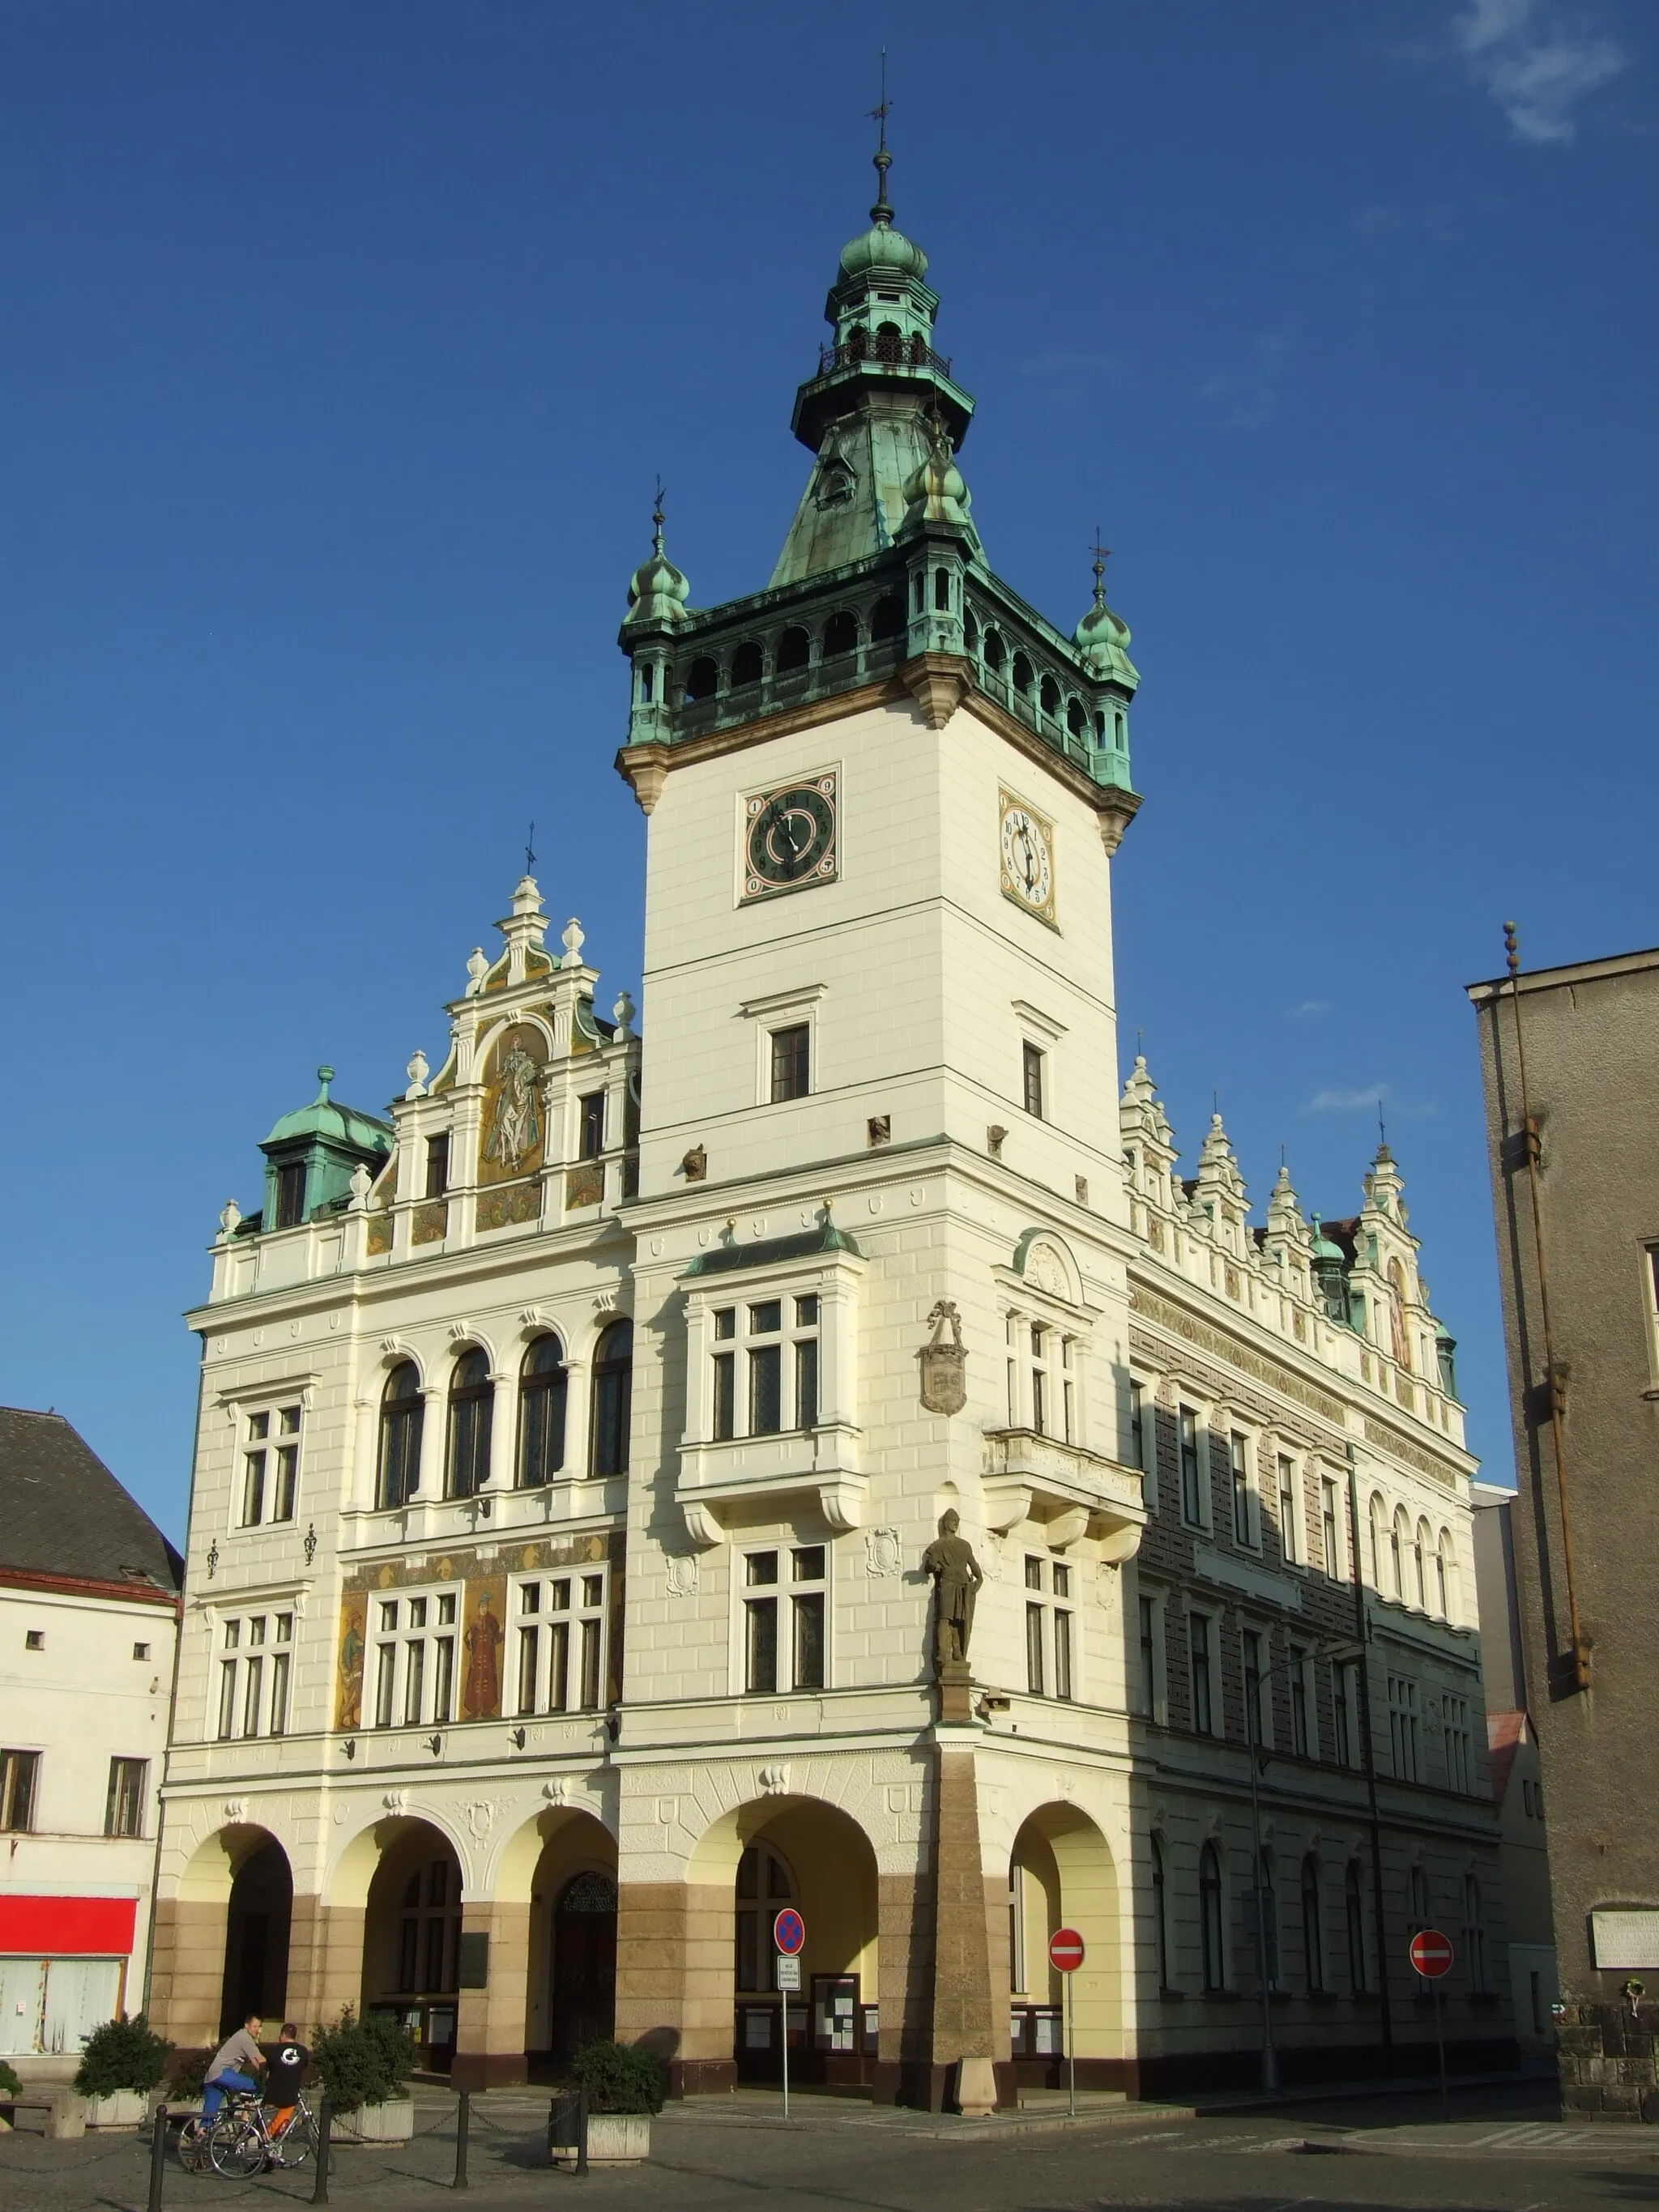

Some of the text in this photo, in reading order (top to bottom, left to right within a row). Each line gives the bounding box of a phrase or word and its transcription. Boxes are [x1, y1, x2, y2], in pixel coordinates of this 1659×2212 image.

[825, 782, 831, 791] 9
[753, 802, 757, 812] 1
[786, 794, 796, 808] 12
[1013, 812, 1019, 826] 11
[758, 819, 769, 834] 10
[1005, 820, 1013, 835] 10
[755, 839, 761, 853] 9
[814, 842, 821, 854] 4
[1004, 836, 1009, 850] 9
[1040, 847, 1046, 861] 2
[759, 856, 766, 870] 8
[1007, 856, 1013, 870] 8
[1043, 867, 1049, 880] 3
[751, 880, 757, 890] 0
[1016, 876, 1021, 889] 7
[1041, 881, 1047, 895] 4
[1034, 889, 1040, 903] 5
